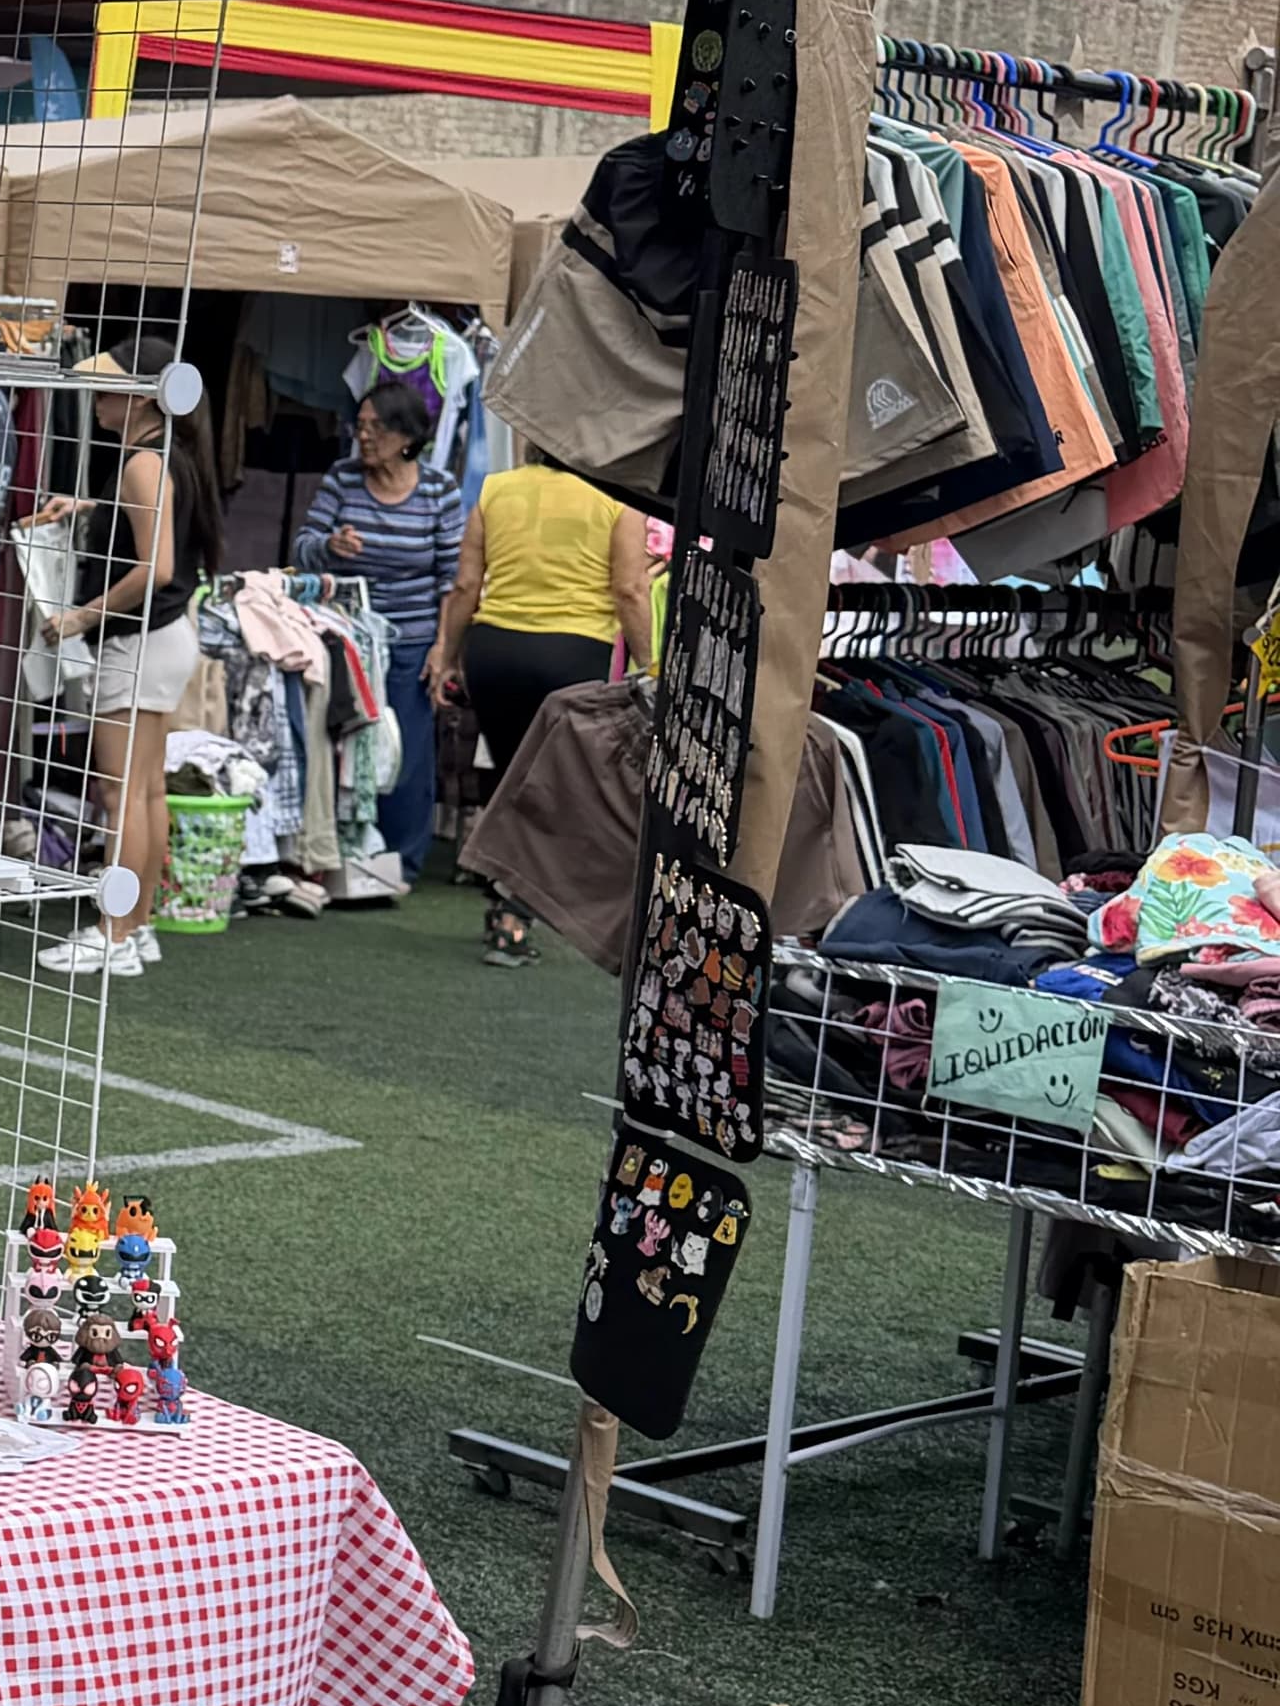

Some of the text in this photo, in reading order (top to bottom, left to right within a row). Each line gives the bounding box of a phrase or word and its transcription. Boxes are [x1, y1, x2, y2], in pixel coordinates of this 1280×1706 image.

[931, 1009, 1106, 1088] LIQUIDACIÓN
[1151, 1602, 1180, 1622] cm
[1193, 1615, 1233, 1641] H35
[1174, 1672, 1220, 1700] KGS
